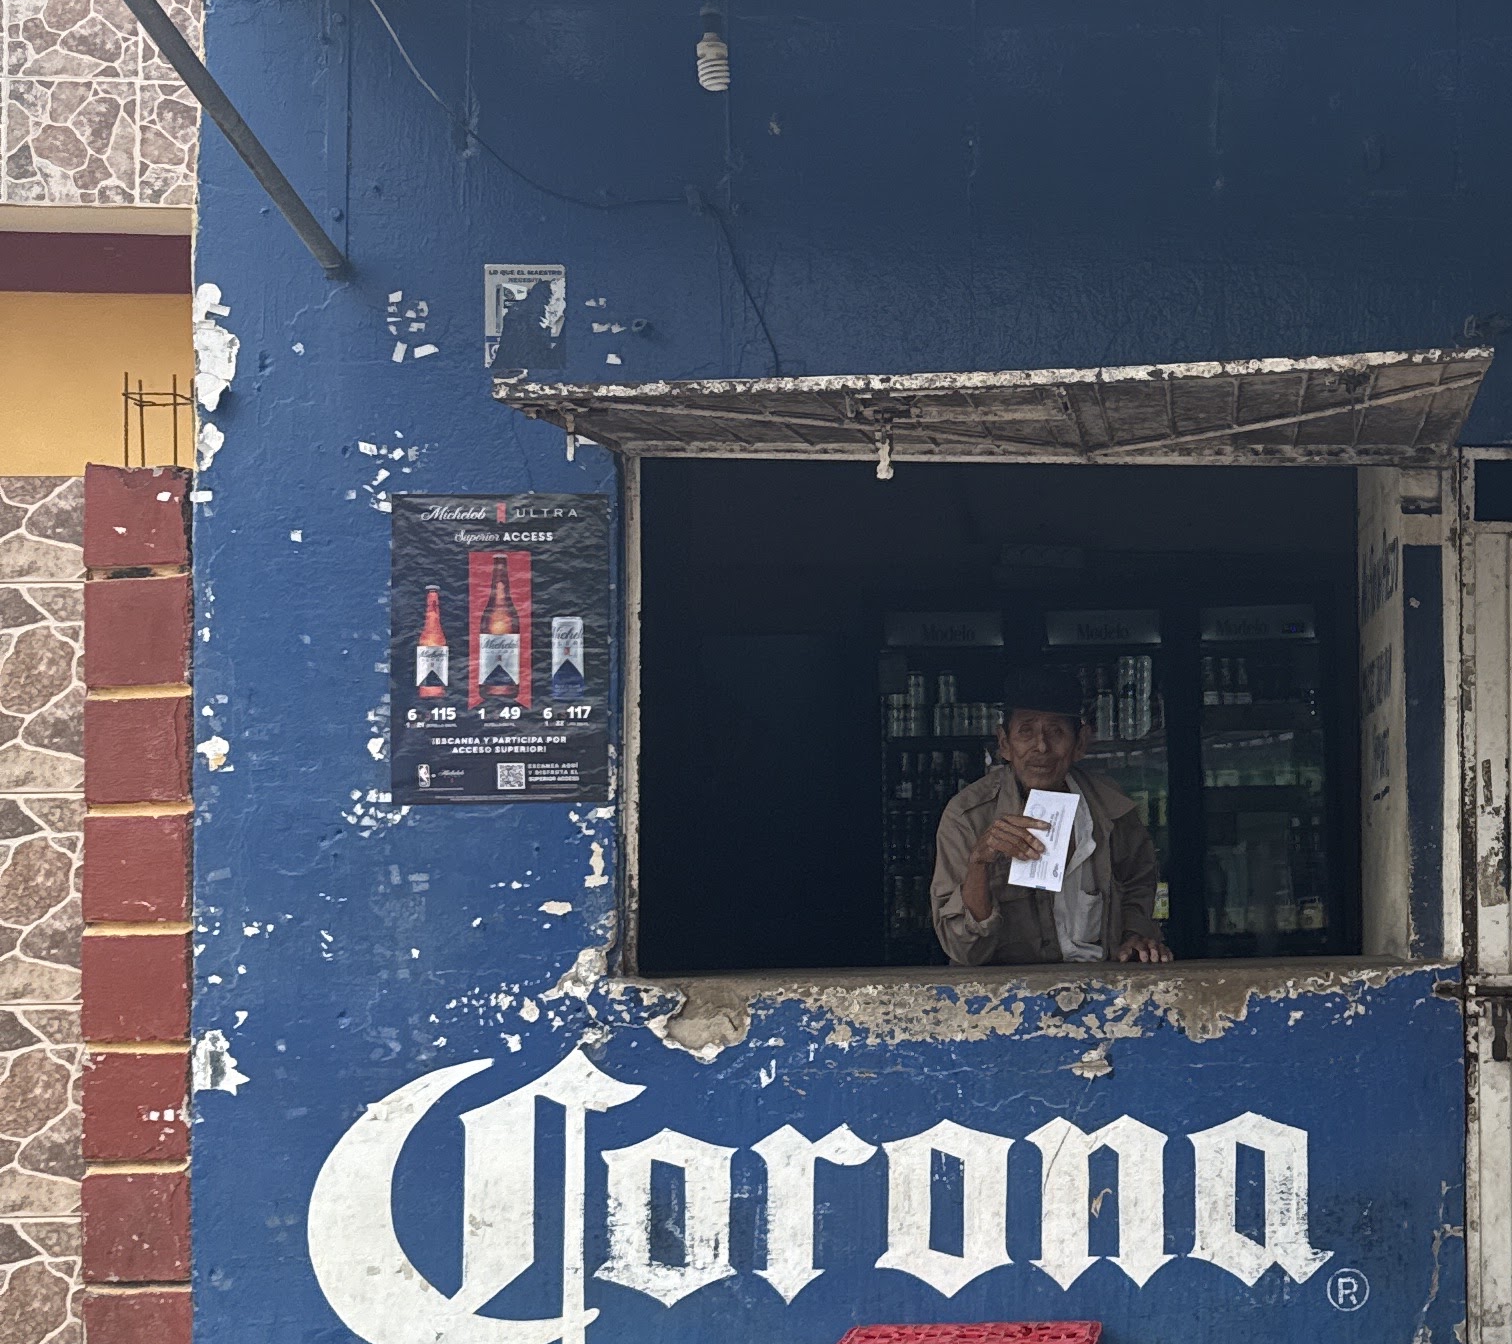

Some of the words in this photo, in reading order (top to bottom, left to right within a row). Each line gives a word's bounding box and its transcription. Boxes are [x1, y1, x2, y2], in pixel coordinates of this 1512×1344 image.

[421, 505, 486, 521] Michelob
[516, 508, 578, 518] ULTRA
[454, 530, 500, 545] Superior
[503, 532, 553, 541] ACCESS
[920, 624, 975, 641] Modelo
[1077, 624, 1129, 640] Modelo
[1215, 619, 1269, 635] Modelo
[407, 708, 417, 720] 6
[478, 709, 485, 720] 1
[543, 708, 553, 720] 6
[546, 736, 567, 744] POR
